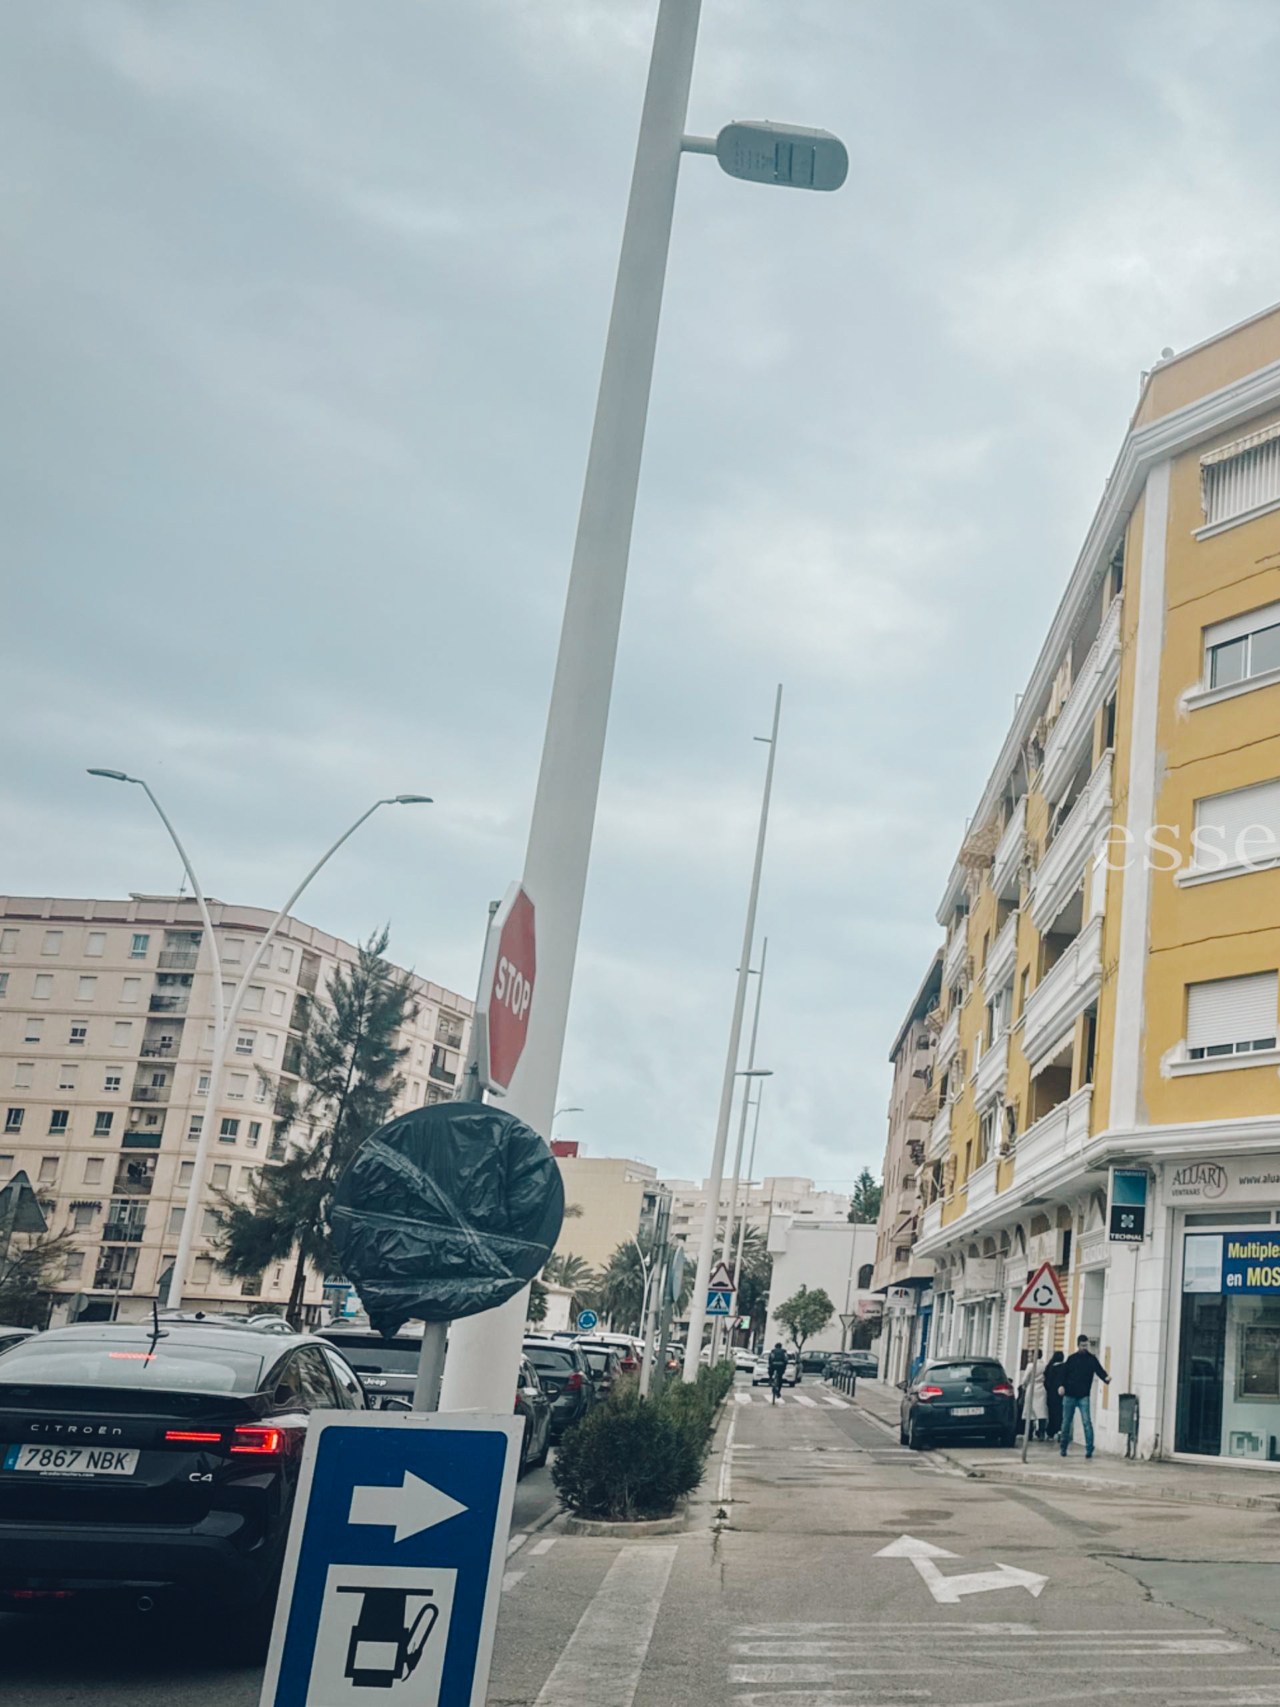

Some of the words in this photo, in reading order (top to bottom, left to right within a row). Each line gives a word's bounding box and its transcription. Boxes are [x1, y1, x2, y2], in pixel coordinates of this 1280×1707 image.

[495, 956, 531, 1021] STOP
[1172, 1164, 1225, 1189] ALUART
[1171, 1187, 1201, 1197] VENTANAS
[1109, 1232, 1143, 1241] TECHNAL
[1226, 1271, 1243, 1287] en
[363, 1377, 387, 1387] Jeep
[24, 1448, 83, 1468] 7867
[86, 1450, 130, 1471] NBK
[188, 1472, 213, 1482] C4
